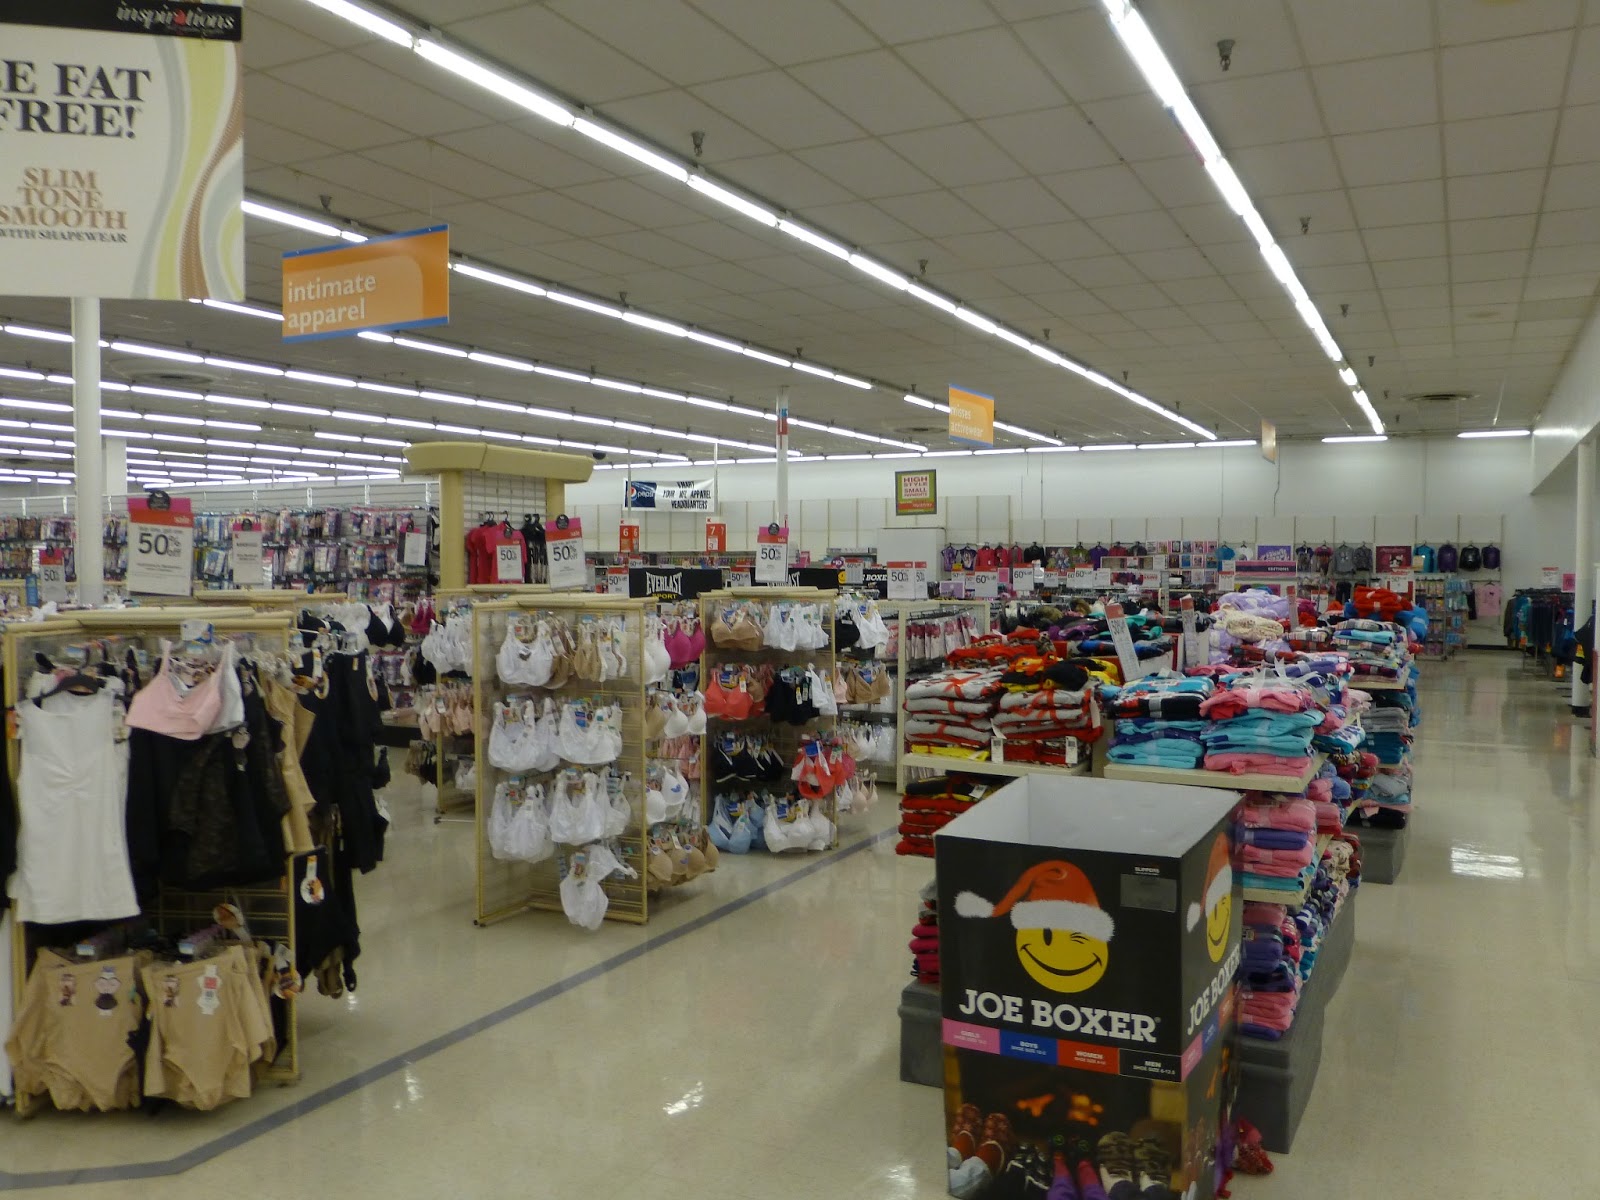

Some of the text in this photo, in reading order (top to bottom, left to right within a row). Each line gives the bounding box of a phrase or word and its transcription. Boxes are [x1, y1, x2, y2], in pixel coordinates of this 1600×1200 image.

[0, 60, 151, 102] E FAT
[24, 167, 98, 189] SLIM
[17, 186, 103, 209] TONE
[39, 229, 128, 242] SHAPEWEAR
[288, 273, 377, 302] intimate
[287, 297, 365, 334] apparel
[637, 490, 655, 499] pepsi
[690, 490, 711, 499] APPAREL
[671, 500, 708, 509] HEADQUARTERS
[623, 528, 629, 536] 6
[710, 526, 715, 535] 7
[646, 571, 683, 596] EVERLAST
[866, 574, 887, 582] BOXE
[1187, 997, 1210, 1035] JOE
[1211, 943, 1240, 1007] BOXER
[959, 989, 1157, 1043] JOE BOXER
[1020, 1040, 1039, 1049] BOYS
[1076, 1050, 1104, 1060] WOMEN
[1144, 1060, 1162, 1068] MEN
